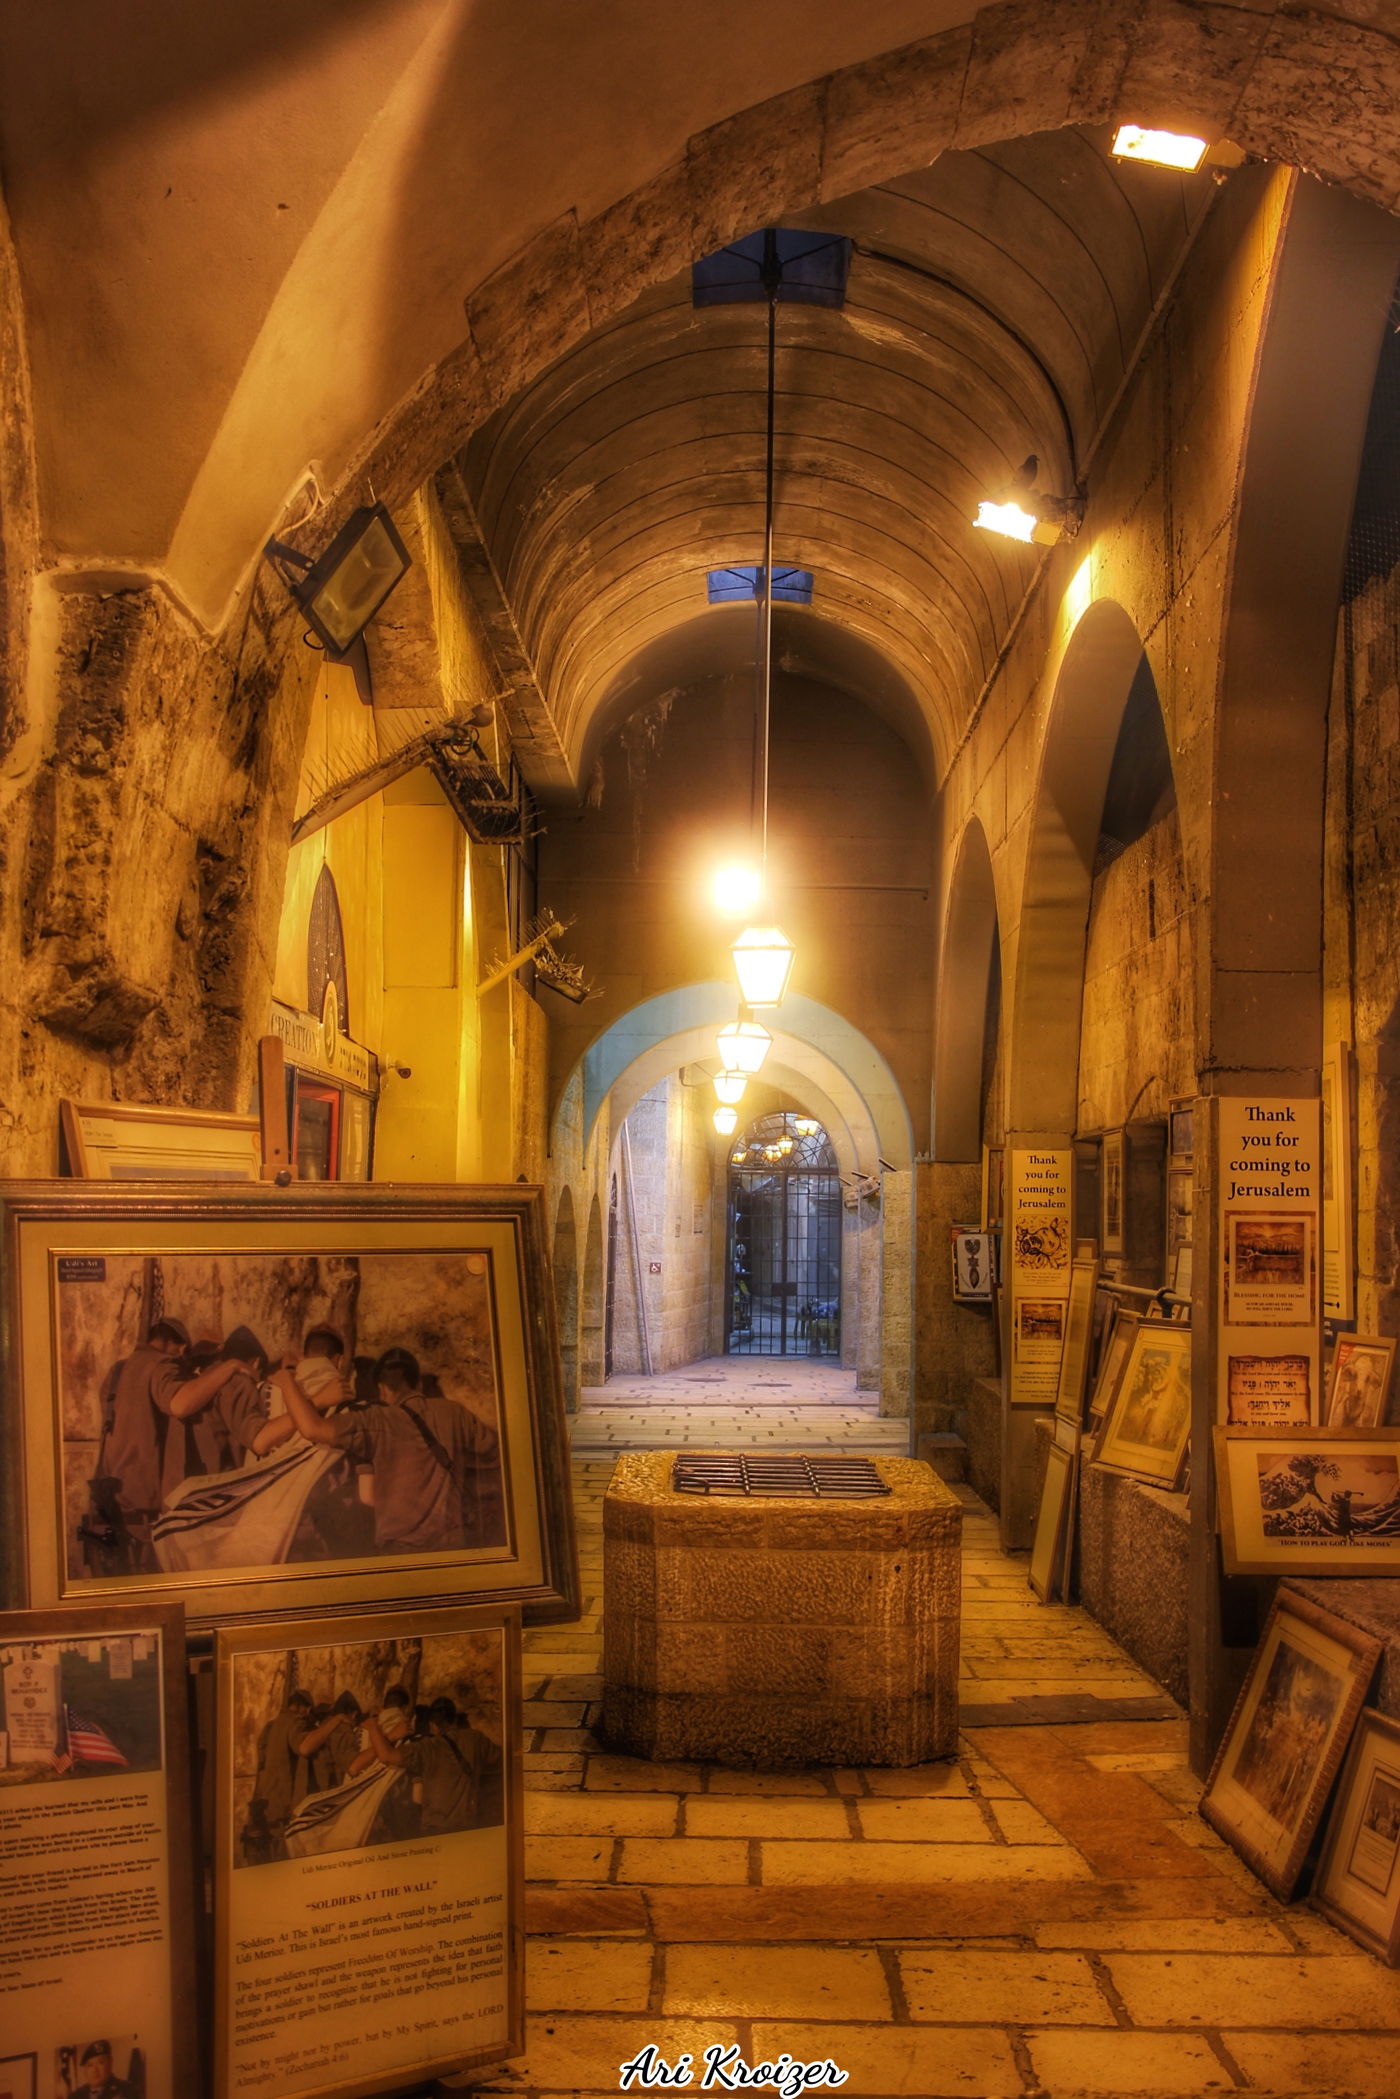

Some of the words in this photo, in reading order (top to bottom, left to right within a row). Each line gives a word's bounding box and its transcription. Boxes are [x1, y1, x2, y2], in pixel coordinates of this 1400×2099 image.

[1245, 1106, 1296, 1122] Thank
[1241, 1136, 1271, 1150] you
[1276, 1131, 1300, 1147] for
[1027, 1155, 1057, 1164] Thank
[1230, 1157, 1291, 1177] coming
[1295, 1160, 1311, 1172] to
[1025, 1172, 1043, 1181] you
[1045, 1169, 1060, 1179] for
[1018, 1185, 1054, 1196] coming
[1227, 1181, 1310, 1200] Jerusalem
[1017, 1199, 1066, 1210] Jerusalem
[364, 1890, 376, 1901] AT
[381, 1886, 401, 1898] THE
[278, 1932, 288, 1943] At
[292, 1928, 308, 1939] The
[338, 1922, 346, 1931] is
[348, 1919, 358, 1929] an
[361, 1912, 392, 1925] artwork
[395, 1905, 425, 1919] created
[427, 1904, 437, 1915] by
[440, 1901, 453, 1911] the
[456, 1896, 480, 1909] Israeli
[482, 1893, 502, 1904] artist
